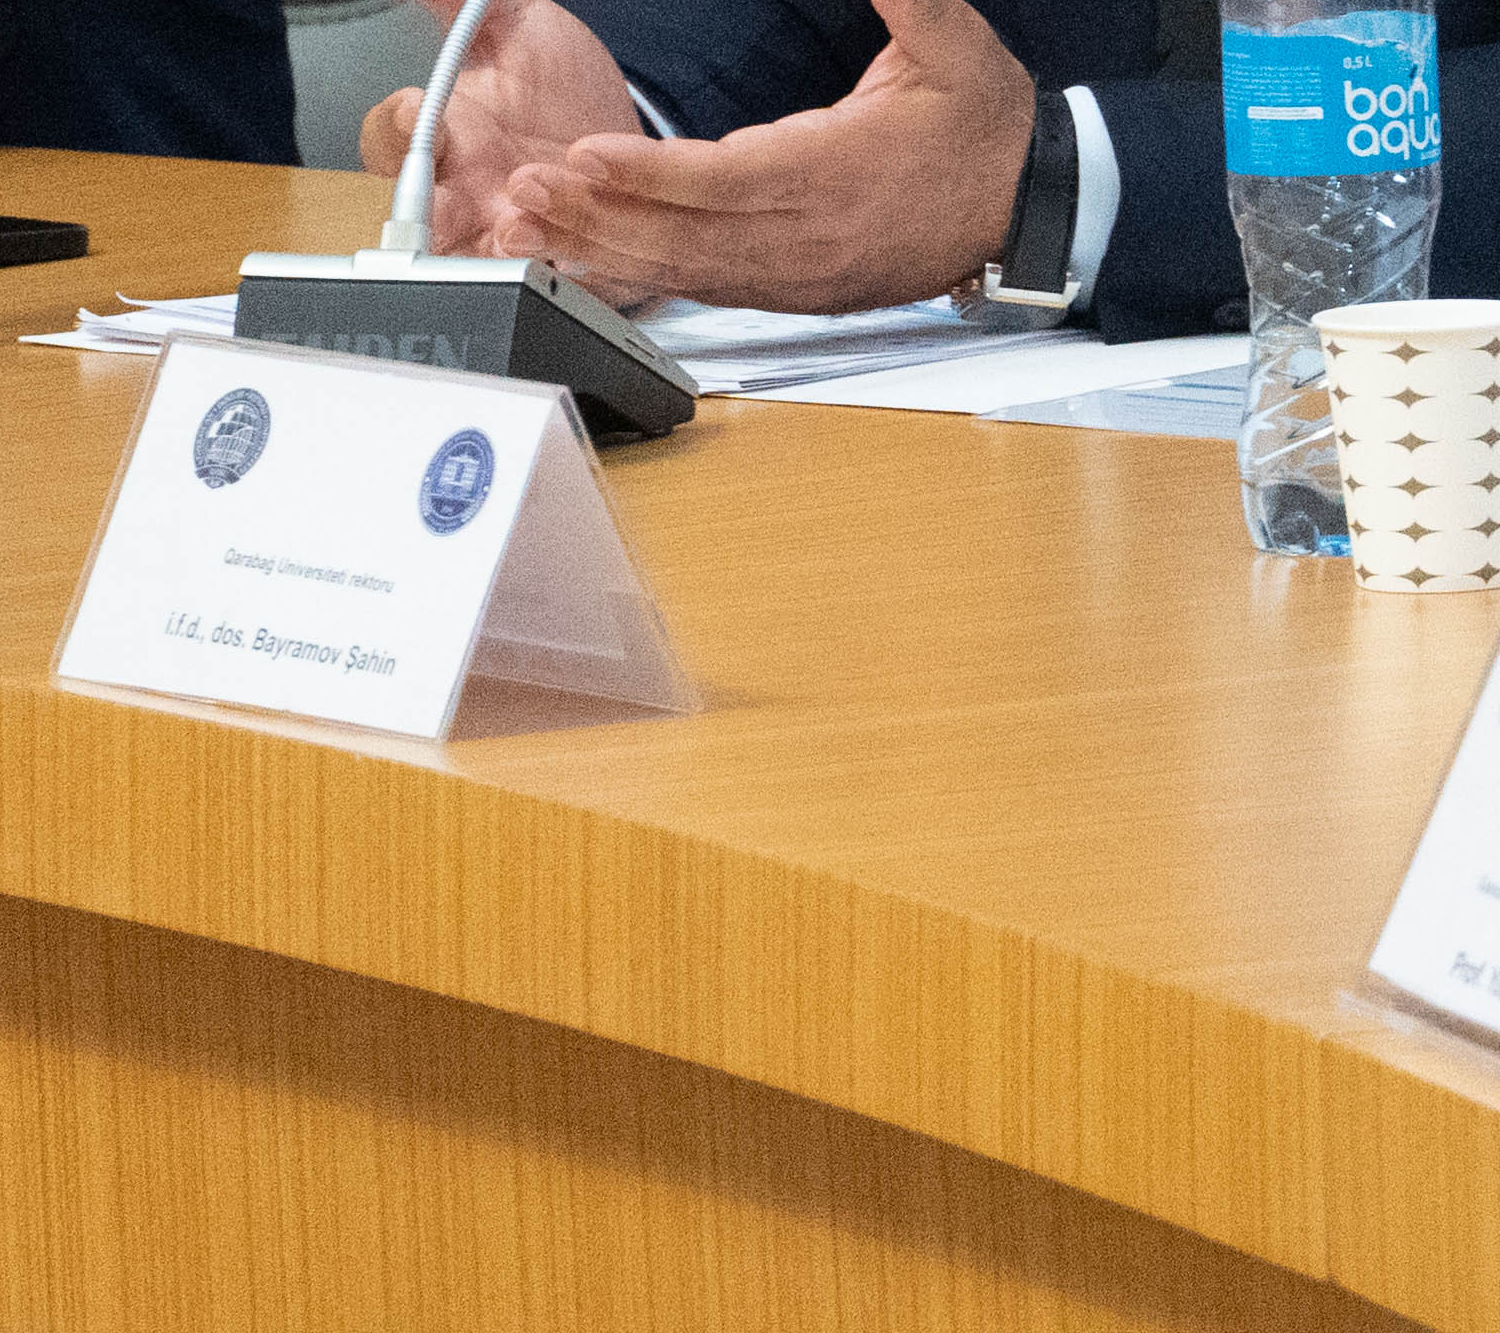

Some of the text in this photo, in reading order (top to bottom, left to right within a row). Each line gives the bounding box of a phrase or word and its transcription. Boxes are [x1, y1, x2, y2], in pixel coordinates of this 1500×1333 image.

[277, 556, 348, 586] Universiteti
[348, 573, 396, 594] rektoru
[211, 620, 246, 648] dos.
[251, 627, 343, 666] Bayramov
[344, 644, 398, 677] Şahin
